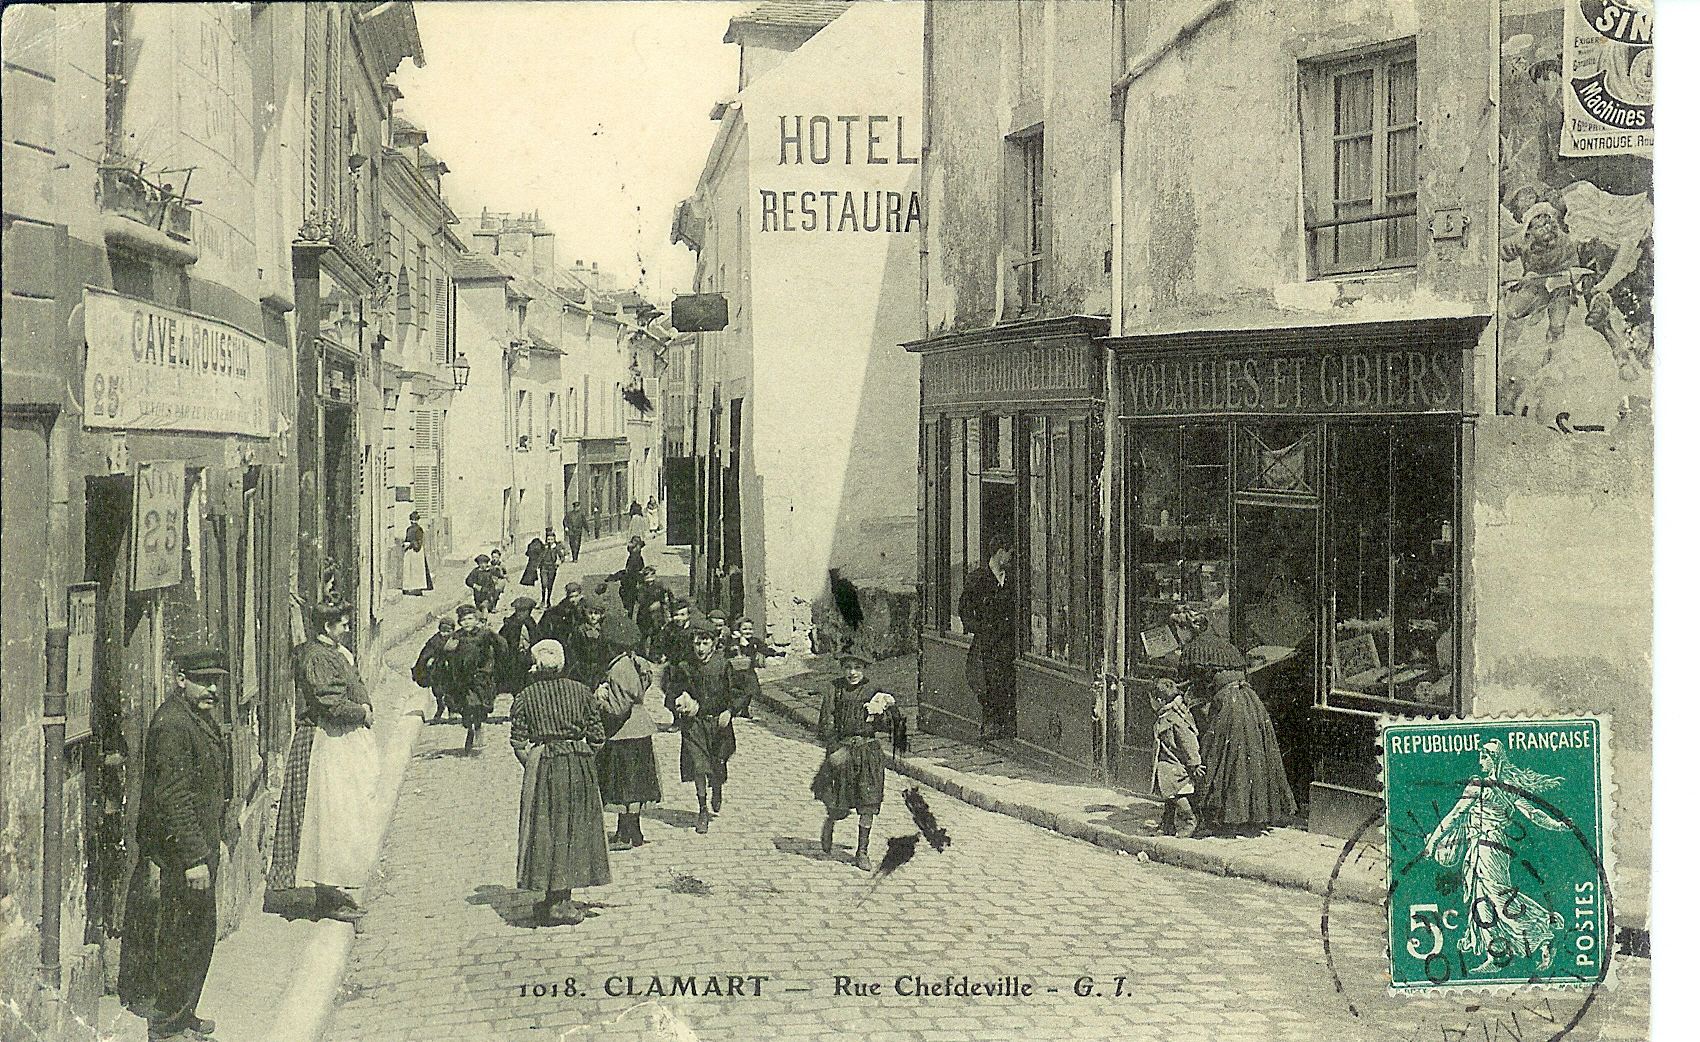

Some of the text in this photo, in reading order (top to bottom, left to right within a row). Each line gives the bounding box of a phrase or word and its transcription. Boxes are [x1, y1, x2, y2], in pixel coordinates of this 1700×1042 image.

[1579, 80, 1646, 127] Machines
[778, 115, 918, 166] HOTEL
[759, 187, 921, 233] RESTAURA
[131, 309, 177, 369] CAVE
[1127, 352, 1452, 415] VOLAILLES ET GIBIERS
[141, 467, 180, 500] VIN
[143, 508, 179, 554] 25
[1508, 730, 1591, 752] FRANÇAISE
[1574, 881, 1596, 967] POSTES
